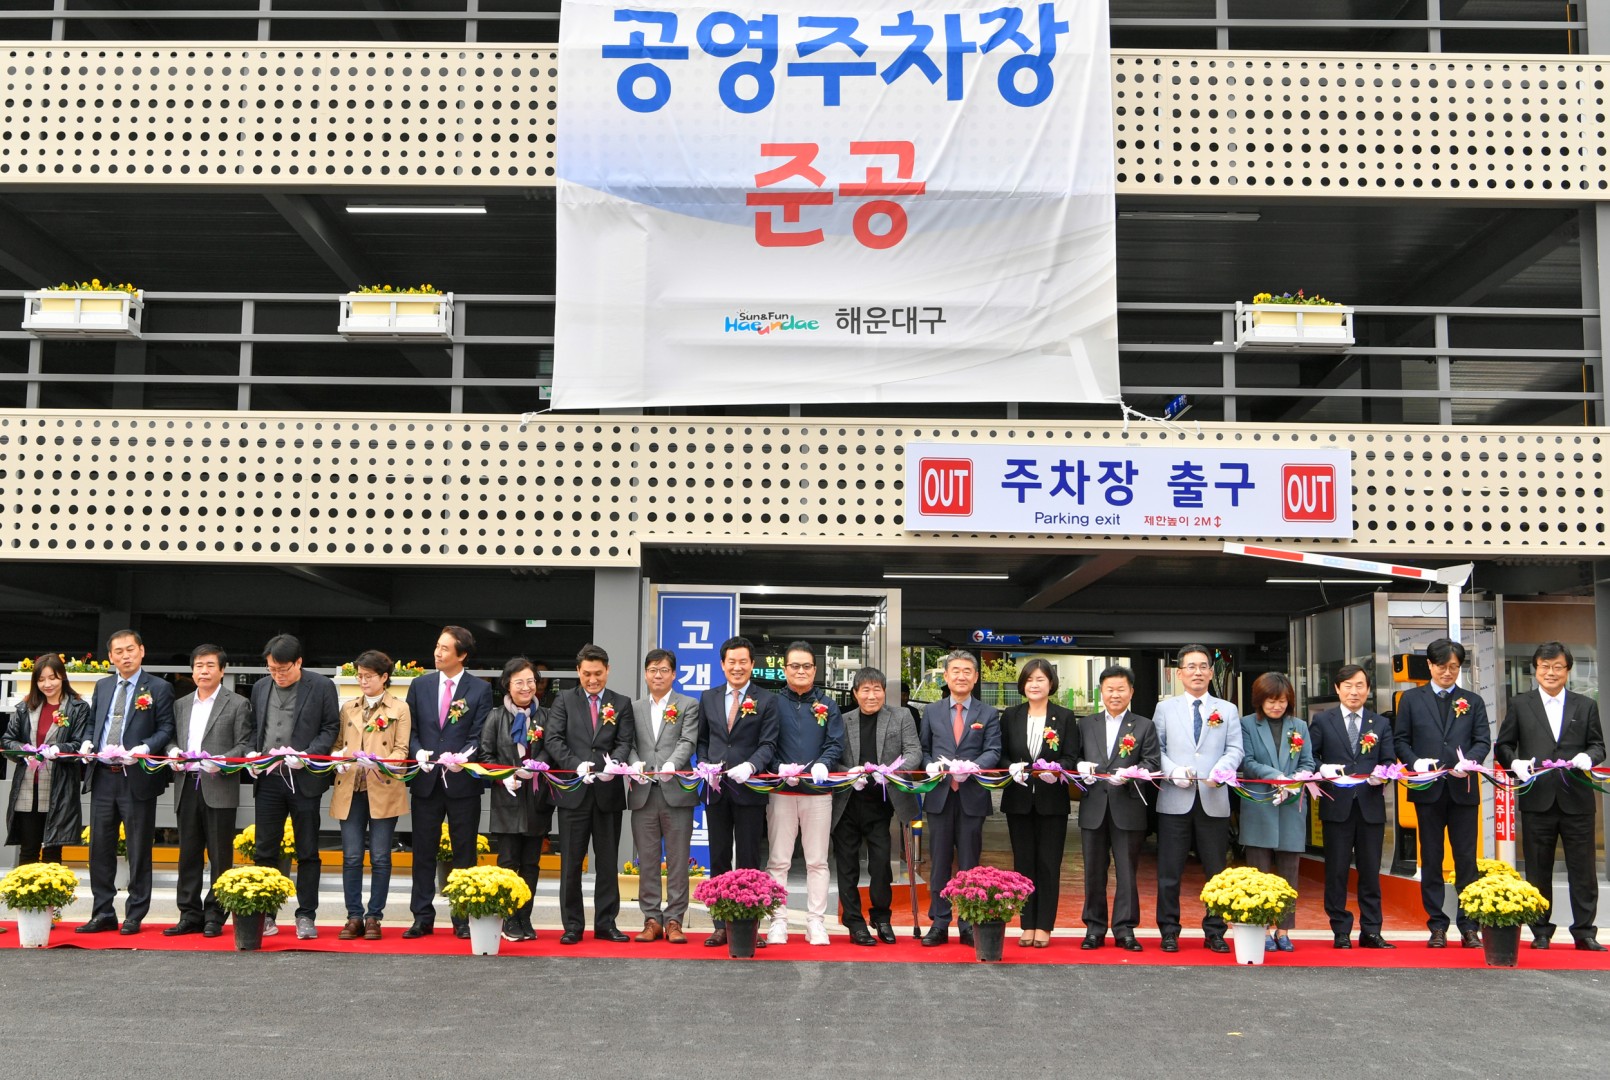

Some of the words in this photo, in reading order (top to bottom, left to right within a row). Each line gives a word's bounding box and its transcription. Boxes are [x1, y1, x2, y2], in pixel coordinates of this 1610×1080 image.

[602, 2, 1069, 114] 공영주차장
[746, 140, 926, 250] 준공
[724, 315, 820, 335] Haeundae
[739, 311, 789, 321] Sun&Fun
[835, 306, 947, 336] 해운대구
[924, 467, 969, 506] OUT
[1001, 459, 1139, 506] 주차장
[1167, 461, 1255, 509] 출구
[1287, 474, 1331, 513] OUT
[1035, 512, 1090, 527] Parking
[1095, 513, 1121, 526] exit
[1144, 515, 1189, 527] 제한높이
[1194, 517, 1211, 526] 2M
